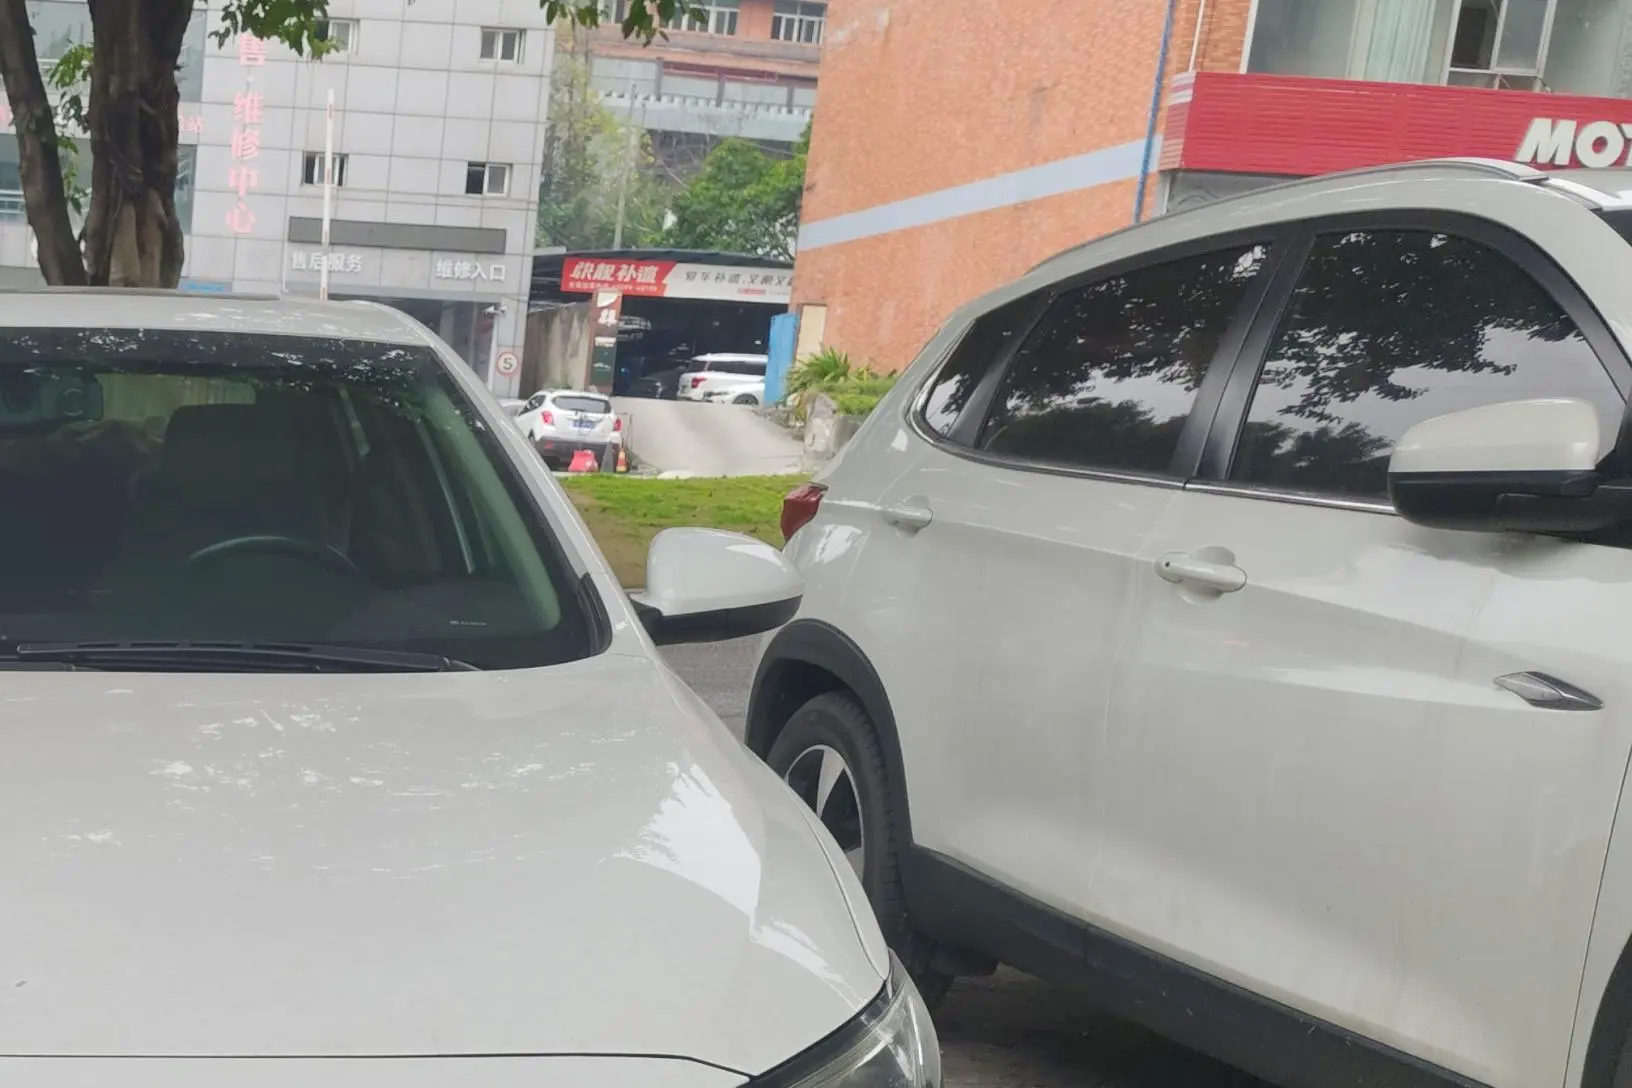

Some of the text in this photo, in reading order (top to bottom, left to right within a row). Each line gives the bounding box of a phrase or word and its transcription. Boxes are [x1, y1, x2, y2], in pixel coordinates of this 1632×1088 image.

[291, 251, 363, 273] 售后服务
[435, 258, 507, 282] 维修入口
[502, 357, 513, 371] 5
